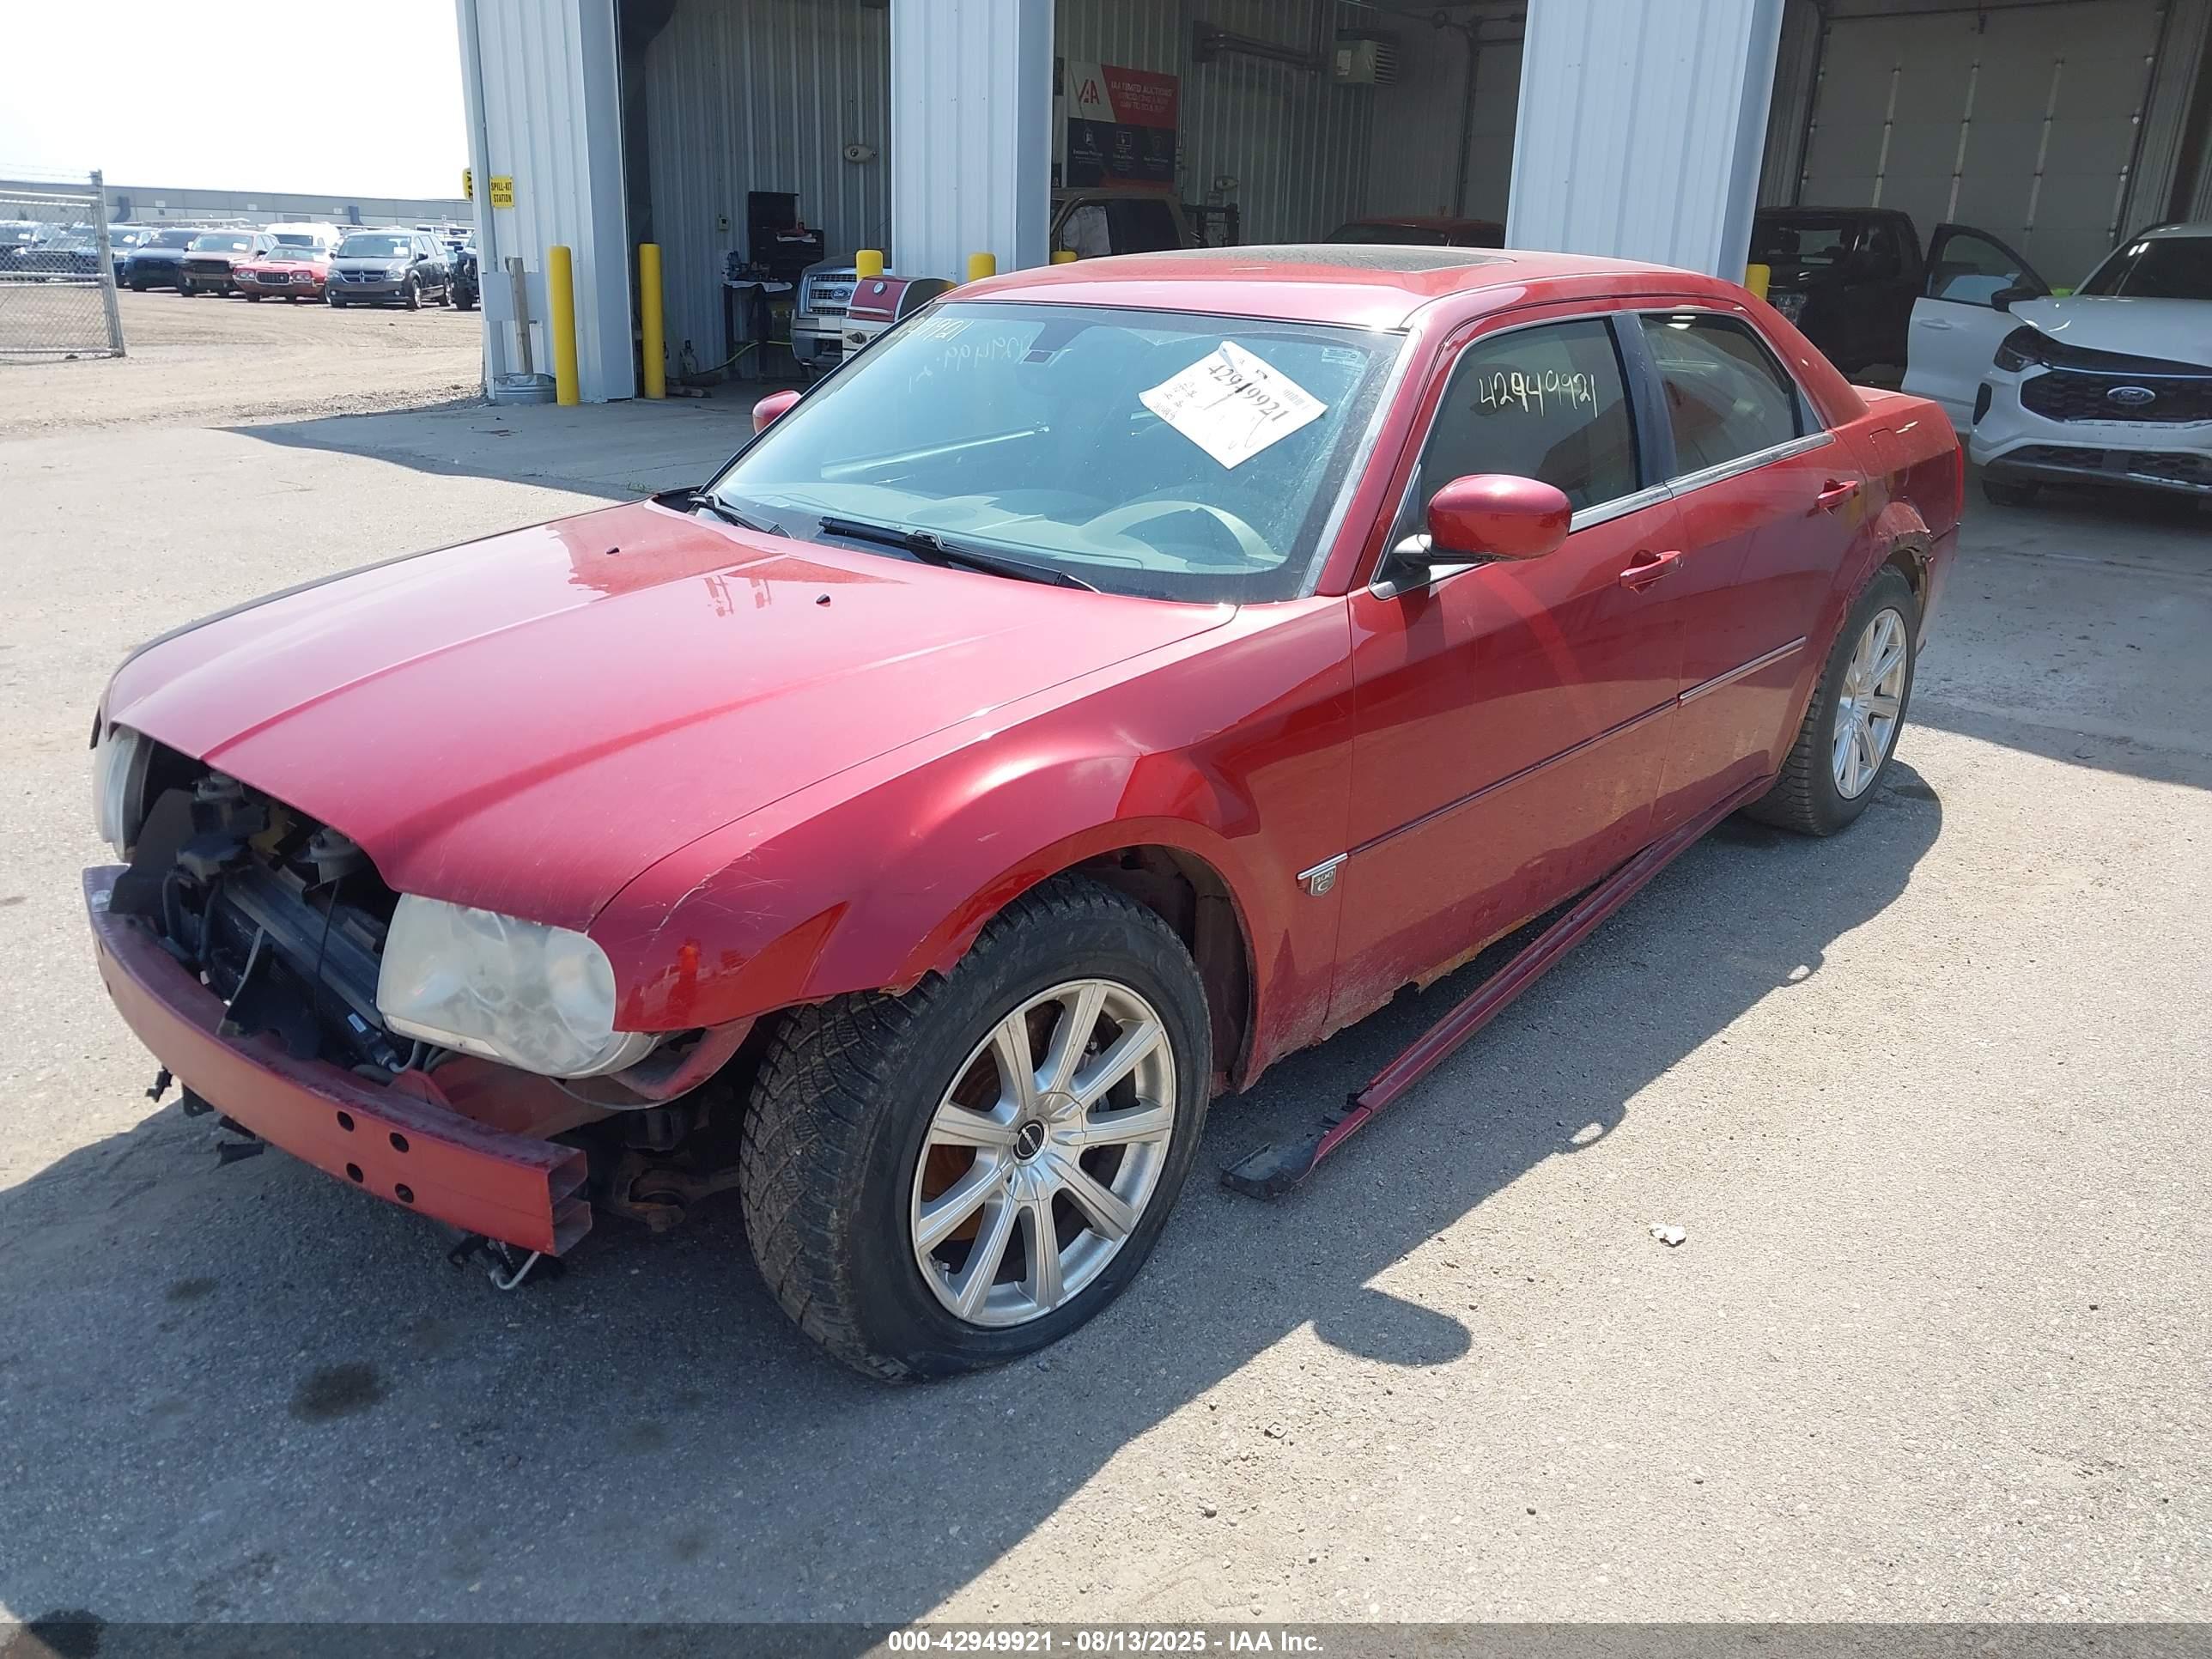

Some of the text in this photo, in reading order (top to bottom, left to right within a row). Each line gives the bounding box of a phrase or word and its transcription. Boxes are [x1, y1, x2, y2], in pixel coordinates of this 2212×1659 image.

[490, 181, 513, 191] SPILL-KIT
[493, 193, 512, 203] STATION
[1479, 370, 1598, 419] 42949921
[1315, 871, 1334, 884] 300
[1317, 880, 1328, 891] C
